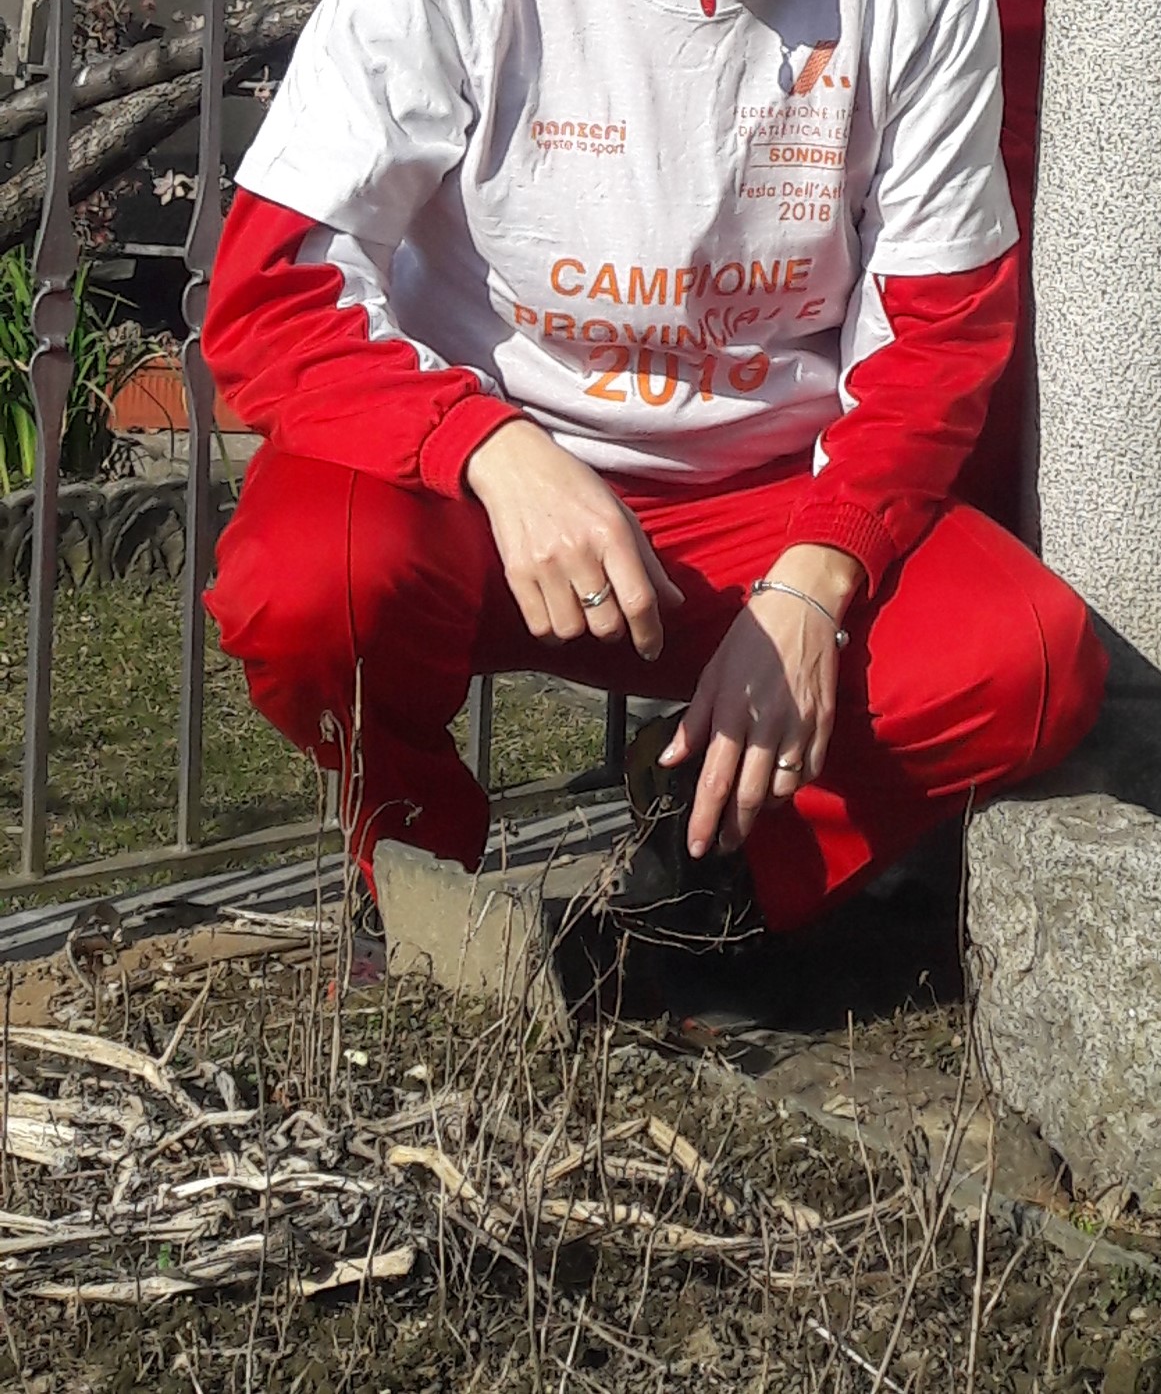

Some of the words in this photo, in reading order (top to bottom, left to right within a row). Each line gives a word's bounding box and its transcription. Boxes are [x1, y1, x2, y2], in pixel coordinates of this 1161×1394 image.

[531, 119, 627, 141] panzeri
[590, 142, 625, 158] sport
[739, 183, 776, 198] Festa
[779, 202, 831, 221] 2018
[550, 258, 813, 306] CAMPIONE
